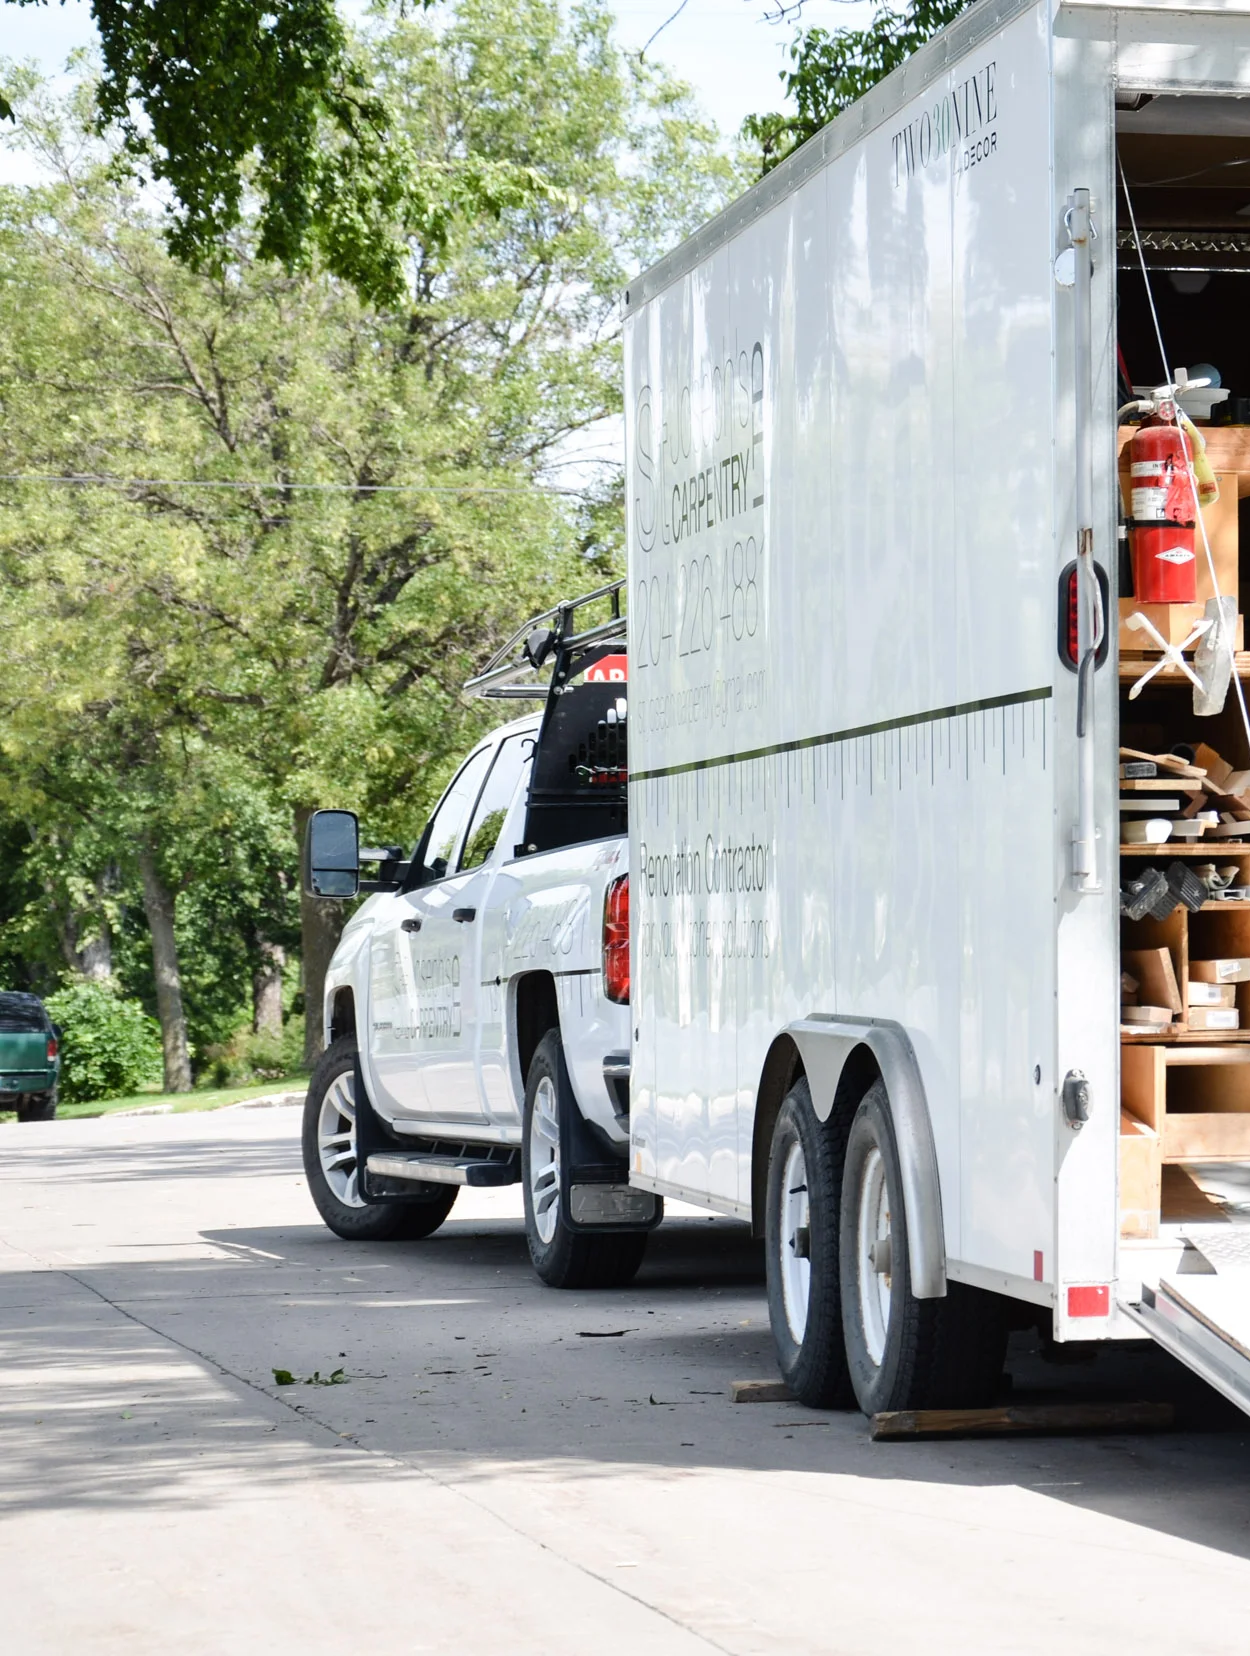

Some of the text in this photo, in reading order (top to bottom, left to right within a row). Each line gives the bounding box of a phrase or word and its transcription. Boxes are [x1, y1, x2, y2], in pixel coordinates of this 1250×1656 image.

[892, 61, 997, 188] TWO30NINE
[964, 131, 997, 171] DECOR
[671, 448, 750, 544] CARPENTRY
[720, 534, 765, 643] 488
[640, 832, 769, 897] Renovation Contractor
